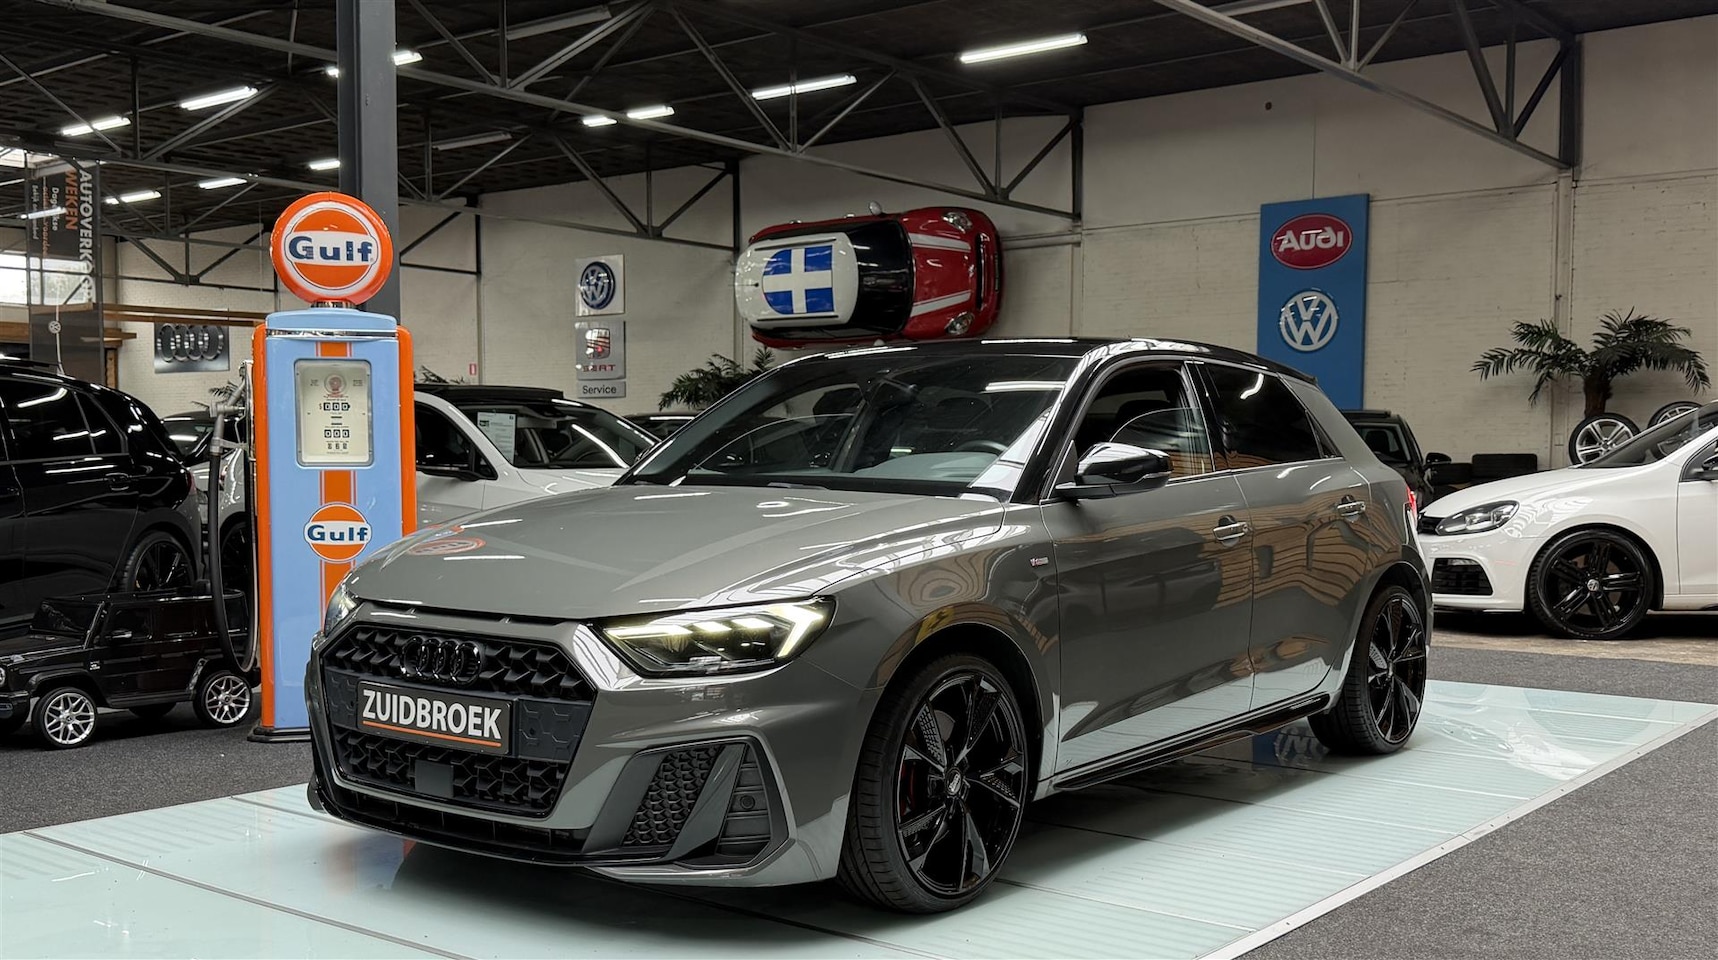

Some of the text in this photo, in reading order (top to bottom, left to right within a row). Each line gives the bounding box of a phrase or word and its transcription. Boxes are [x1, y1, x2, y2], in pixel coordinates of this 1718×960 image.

[65, 169, 78, 230] WEKEN
[288, 236, 373, 262] Gulf
[582, 385, 617, 395] Service
[307, 524, 368, 542] Gulf
[362, 689, 502, 740] ZUIDBROEK
